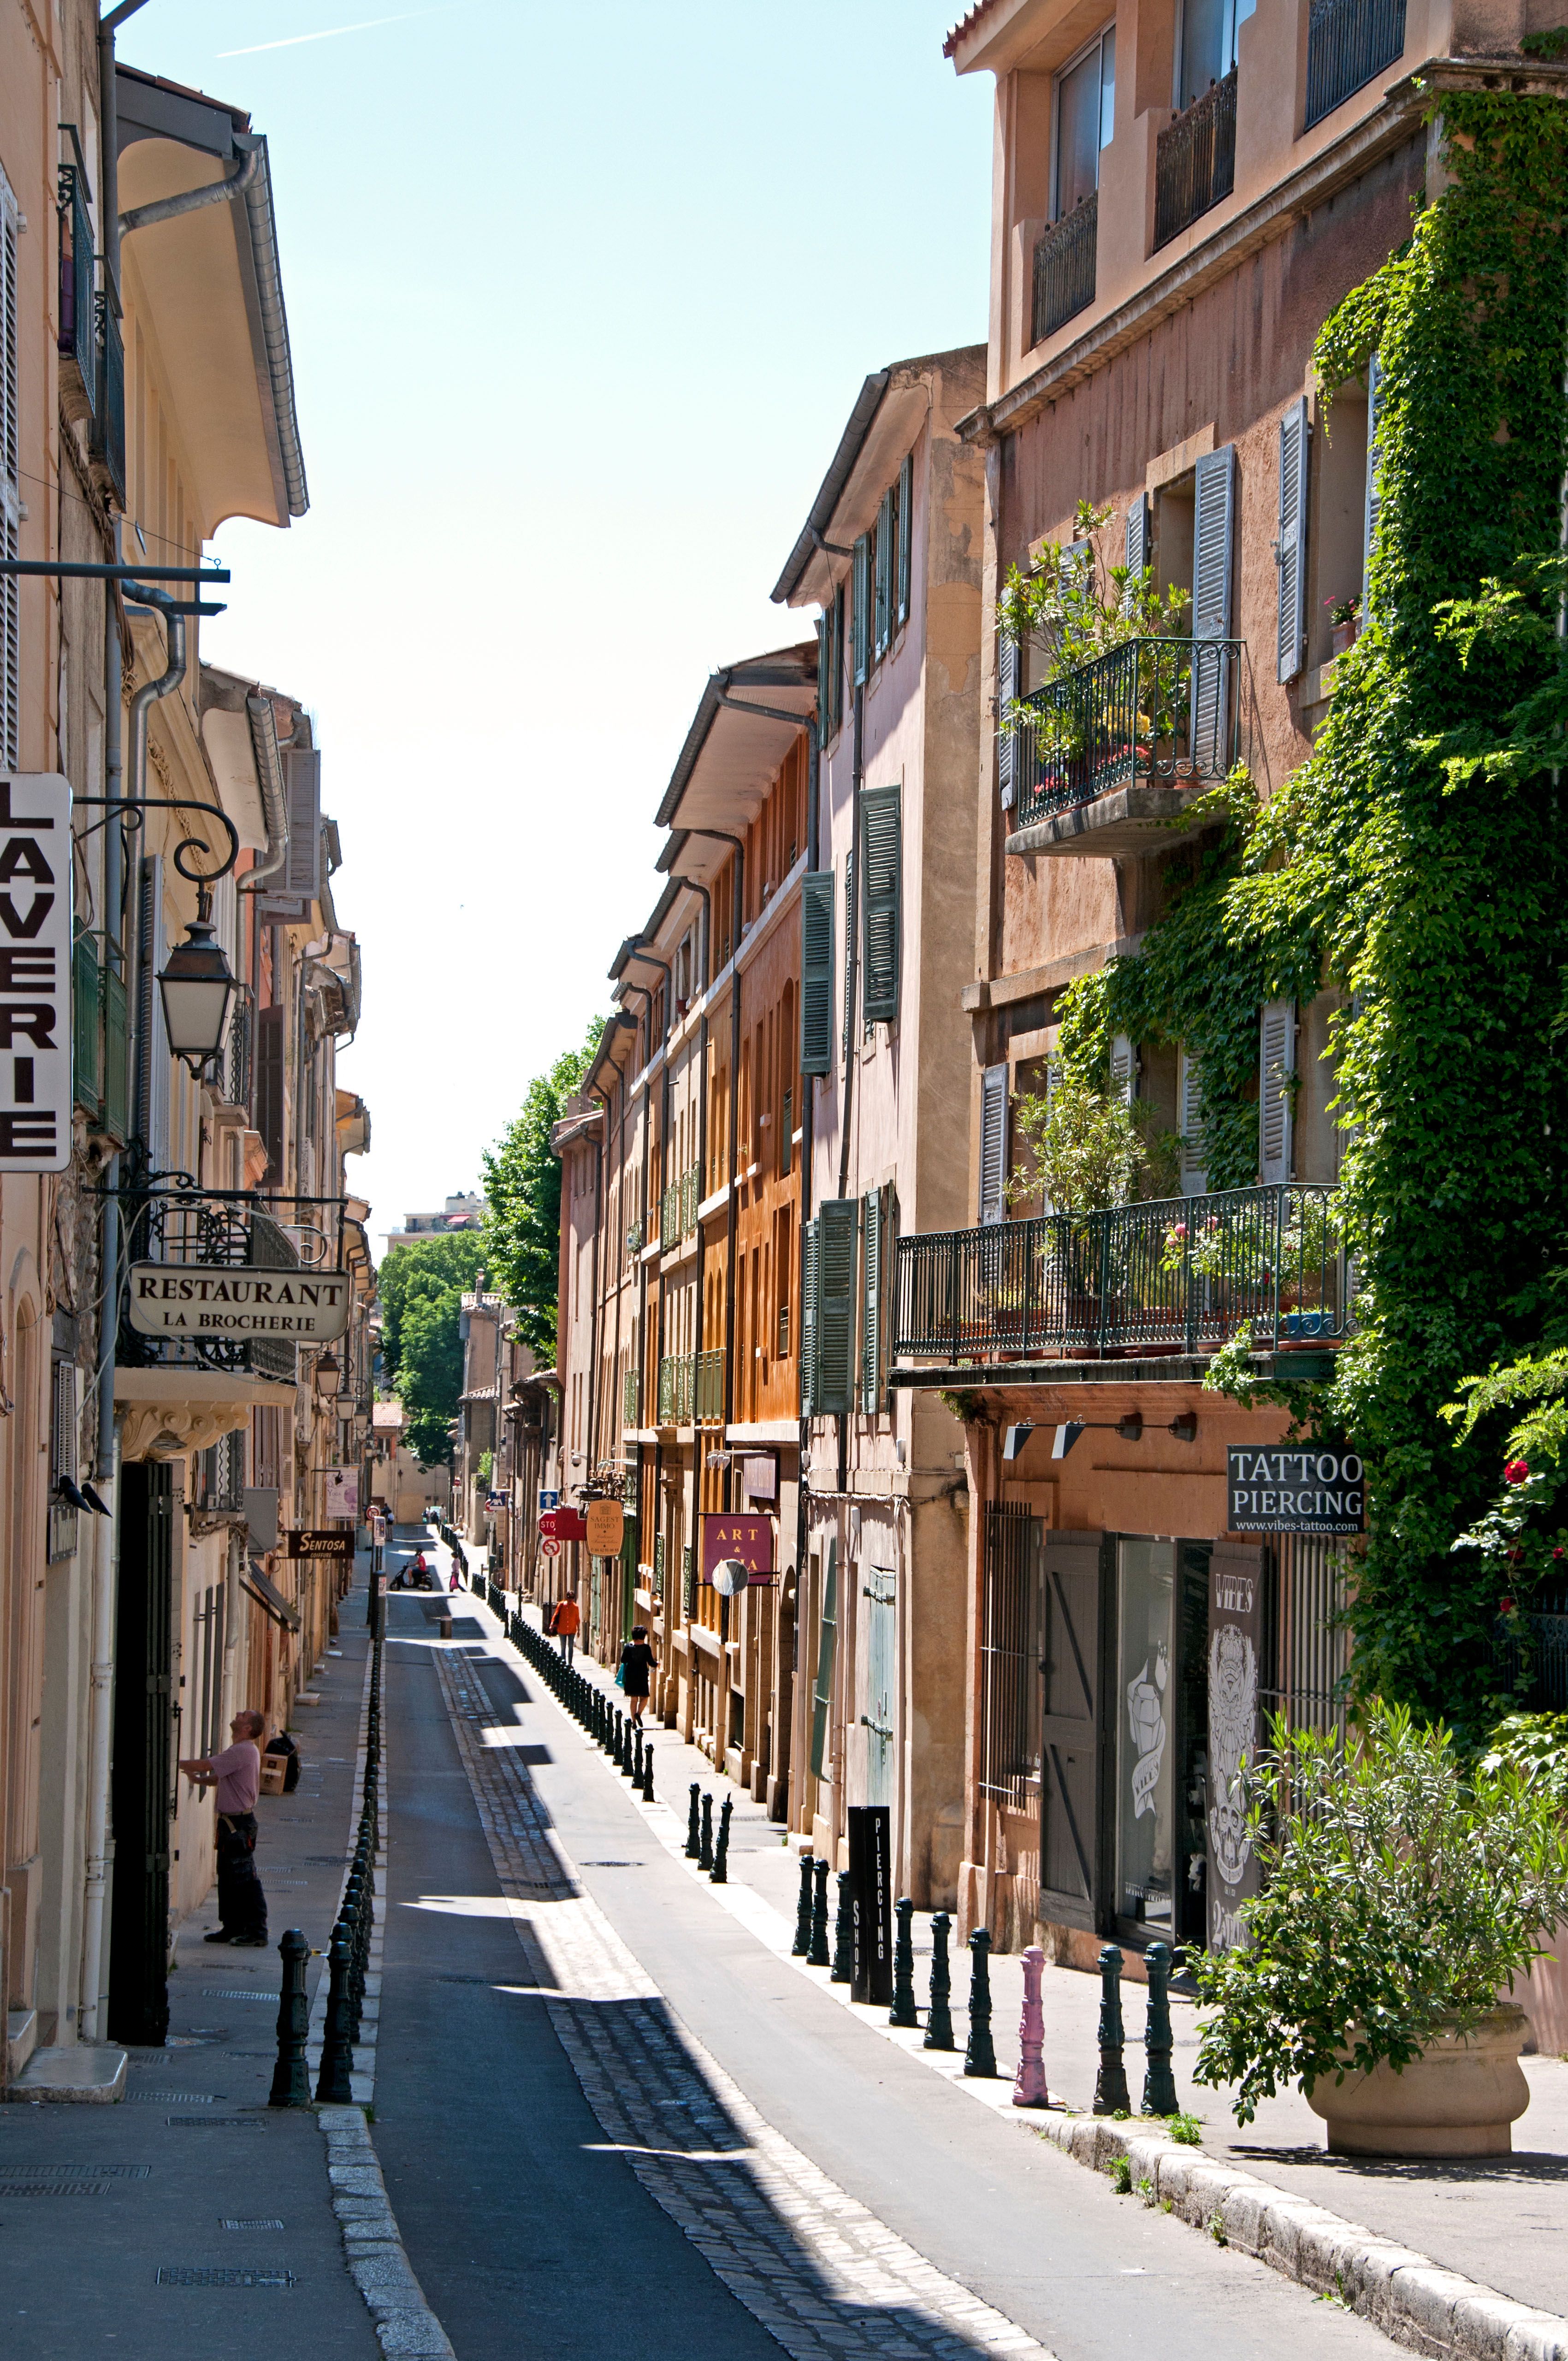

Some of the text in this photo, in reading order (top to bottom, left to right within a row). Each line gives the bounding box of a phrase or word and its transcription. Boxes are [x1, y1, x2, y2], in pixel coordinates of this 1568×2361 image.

[0, 783, 58, 1157] LAVERIE
[137, 1277, 343, 1307] RESTAURANT
[163, 1312, 315, 1331] LA BROCHERIE
[1231, 1453, 1363, 1483] TATTOO
[1233, 1490, 1362, 1515] PIERCING
[716, 1529, 758, 1541] ART
[1236, 1520, 1358, 1531] www.vibes-tattoo.com
[1216, 1573, 1254, 1613] VIBES
[1133, 1754, 1159, 1796] VIBES
[876, 1818, 884, 1959] PIERCING
